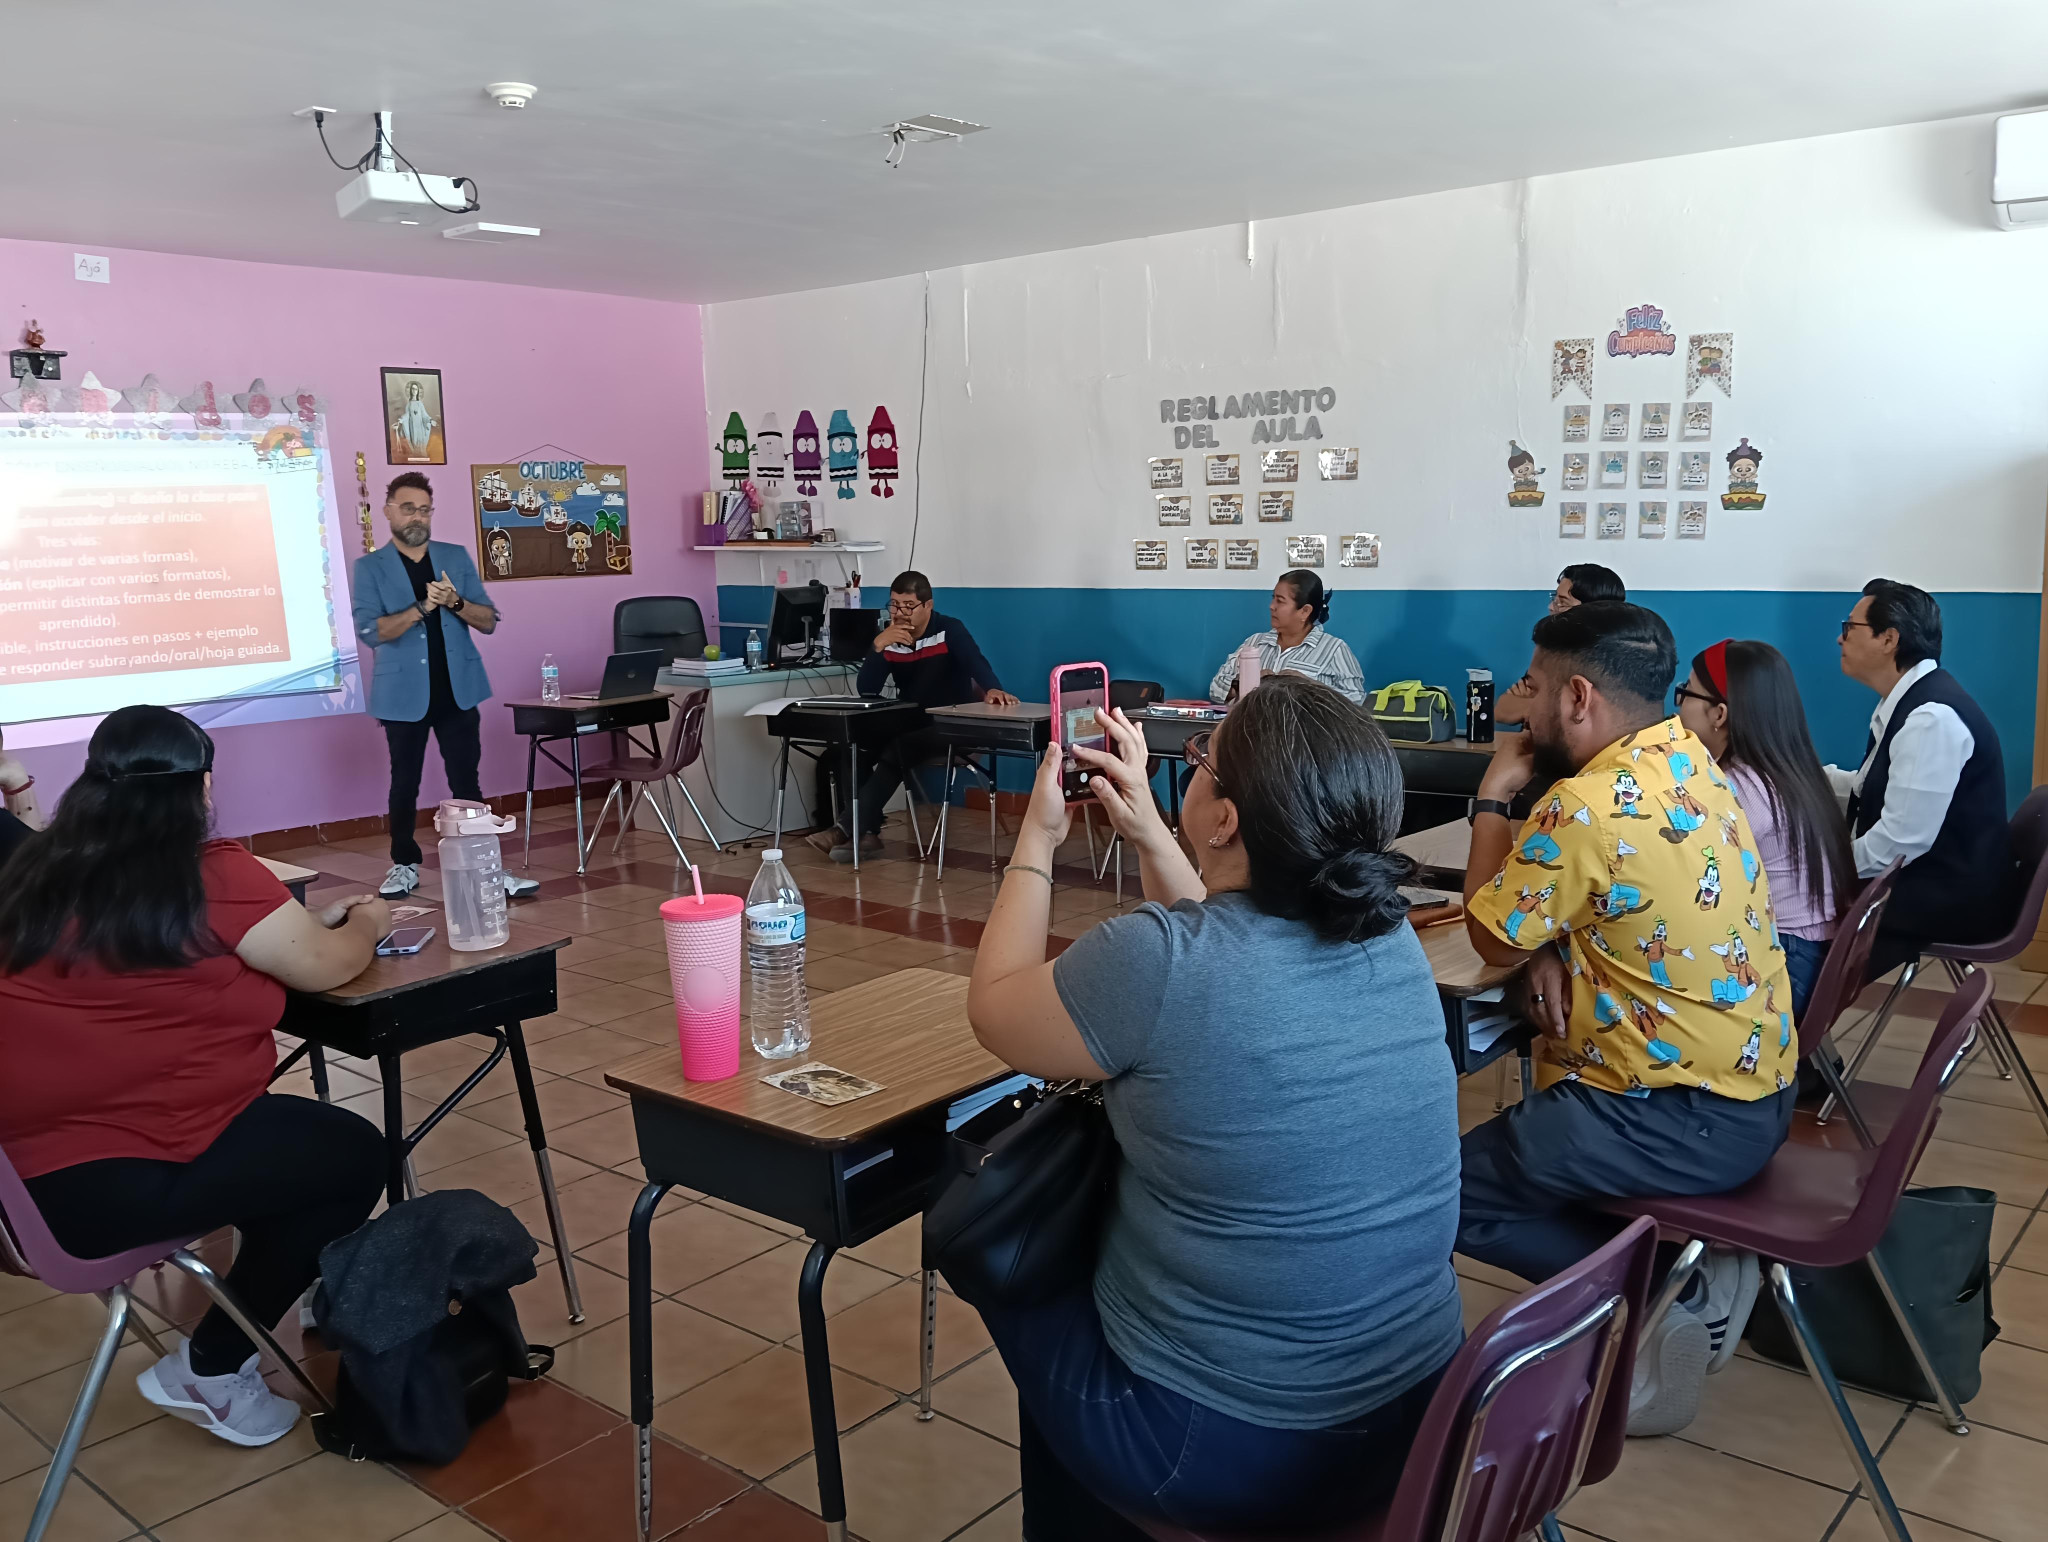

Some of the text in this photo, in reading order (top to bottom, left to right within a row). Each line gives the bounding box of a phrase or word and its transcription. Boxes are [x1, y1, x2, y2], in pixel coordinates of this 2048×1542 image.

[1626, 304, 1663, 332] Feliz
[1607, 331, 1676, 358] Cumpleaños
[1160, 386, 1336, 424] REGLAMENTO
[1174, 416, 1323, 449] DEL AULA
[519, 462, 586, 480] OCTUBRE
[108, 511, 149, 525] desde
[152, 511, 165, 524] el
[37, 535, 67, 549] Tres
[13, 553, 74, 572] (motivar
[79, 553, 97, 566] de
[98, 551, 140, 566] varias
[143, 549, 198, 564] formas),
[26, 575, 87, 592] (explicar
[90, 575, 116, 587] con
[119, 570, 160, 586] varios
[162, 566, 231, 582] formatos),
[61, 590, 121, 609] distintas
[123, 589, 172, 605] formas
[174, 589, 191, 602] de
[194, 586, 262, 601] demostrar
[263, 584, 276, 597] lo
[39, 613, 121, 633] aprendido).
[35, 634, 129, 653] instrucciones
[131, 632, 150, 646] en
[153, 630, 192, 645] pasos
[194, 630, 203, 639] +
[206, 625, 260, 642] ejemplo
[11, 656, 85, 677] responder
[88, 645, 235, 670] subrayando/oral/hoja
[237, 641, 284, 660] guiada.
